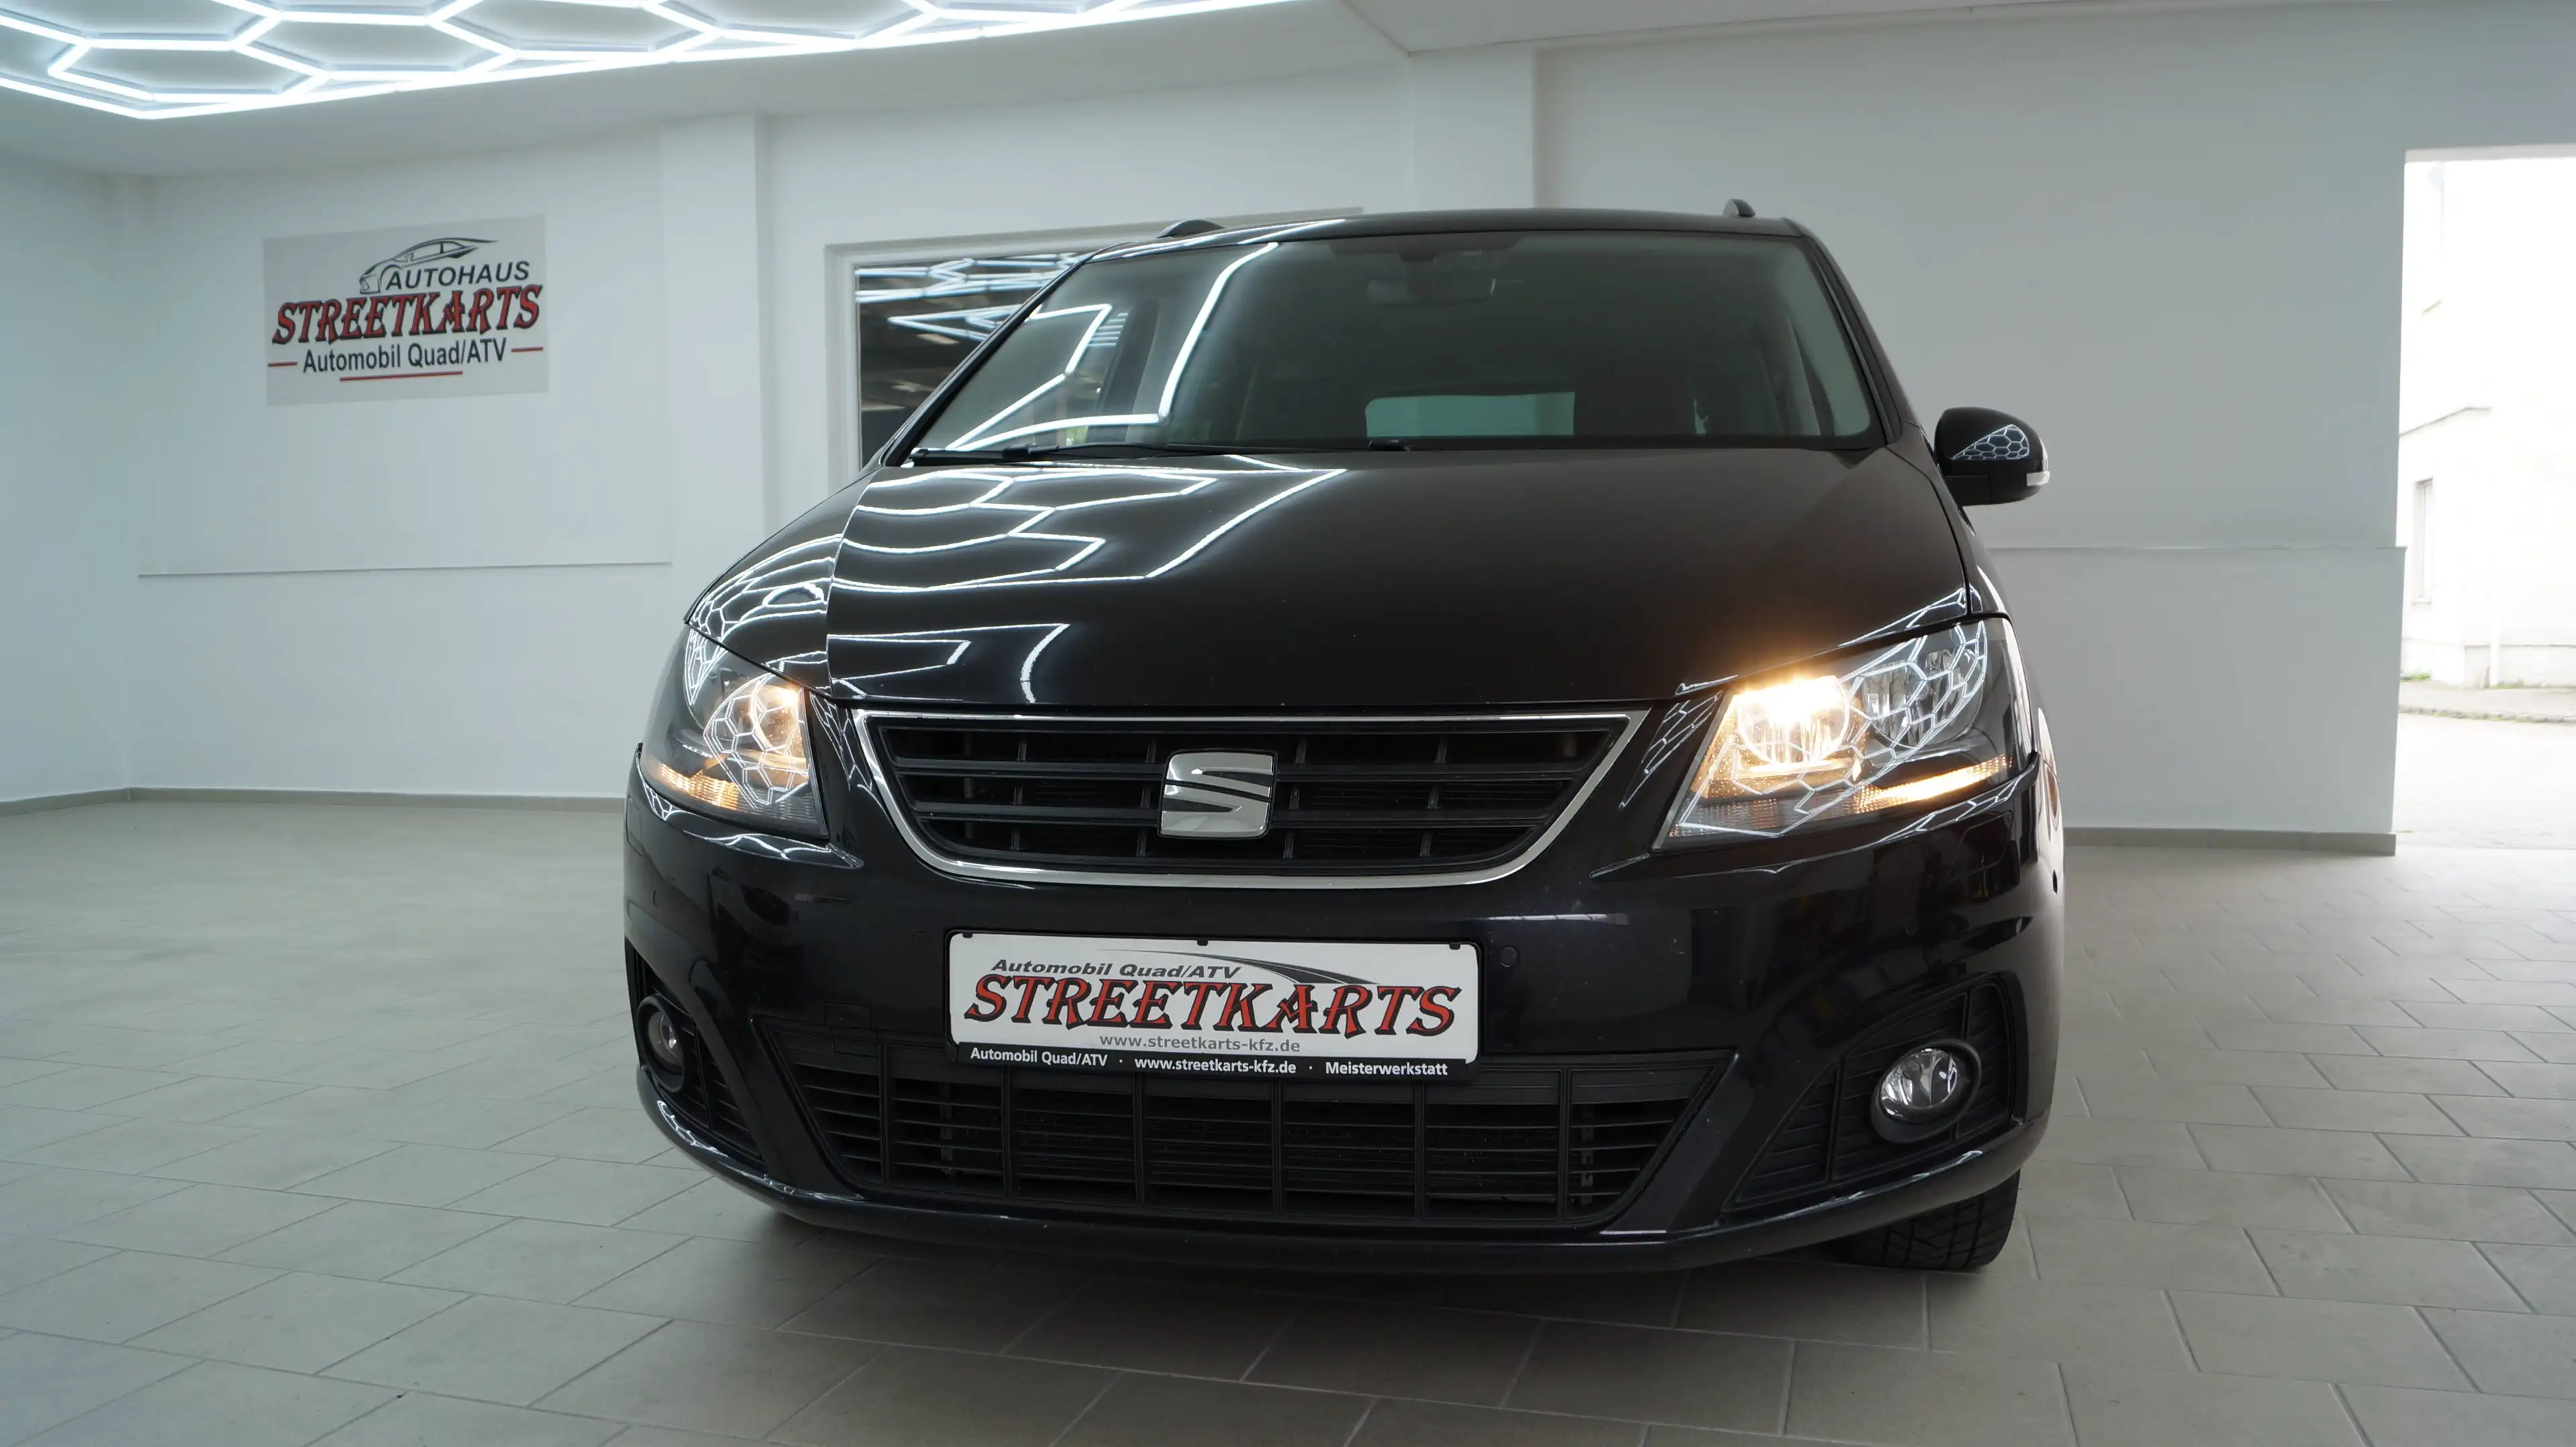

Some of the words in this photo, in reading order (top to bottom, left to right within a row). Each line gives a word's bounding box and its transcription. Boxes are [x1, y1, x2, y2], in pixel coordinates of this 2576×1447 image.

[386, 261, 530, 290] AUTOHAUS
[272, 284, 543, 345] STREETKARTS
[303, 344, 401, 374] Automobil
[407, 337, 507, 368] Quad/ATV
[991, 959, 1112, 975] Automobil
[1119, 963, 1242, 979] Quad/ATV
[963, 974, 1462, 1039] STREETKARTS
[1099, 1035, 1300, 1052] www.streetkarts-kfz.de
[970, 1047, 1038, 1063] Automobil
[1042, 1051, 1108, 1067] Quad/ATV
[1134, 1058, 1297, 1074] www.streetkarts-kfz.de
[1326, 1061, 1448, 1076] Meisterwerkstatt
